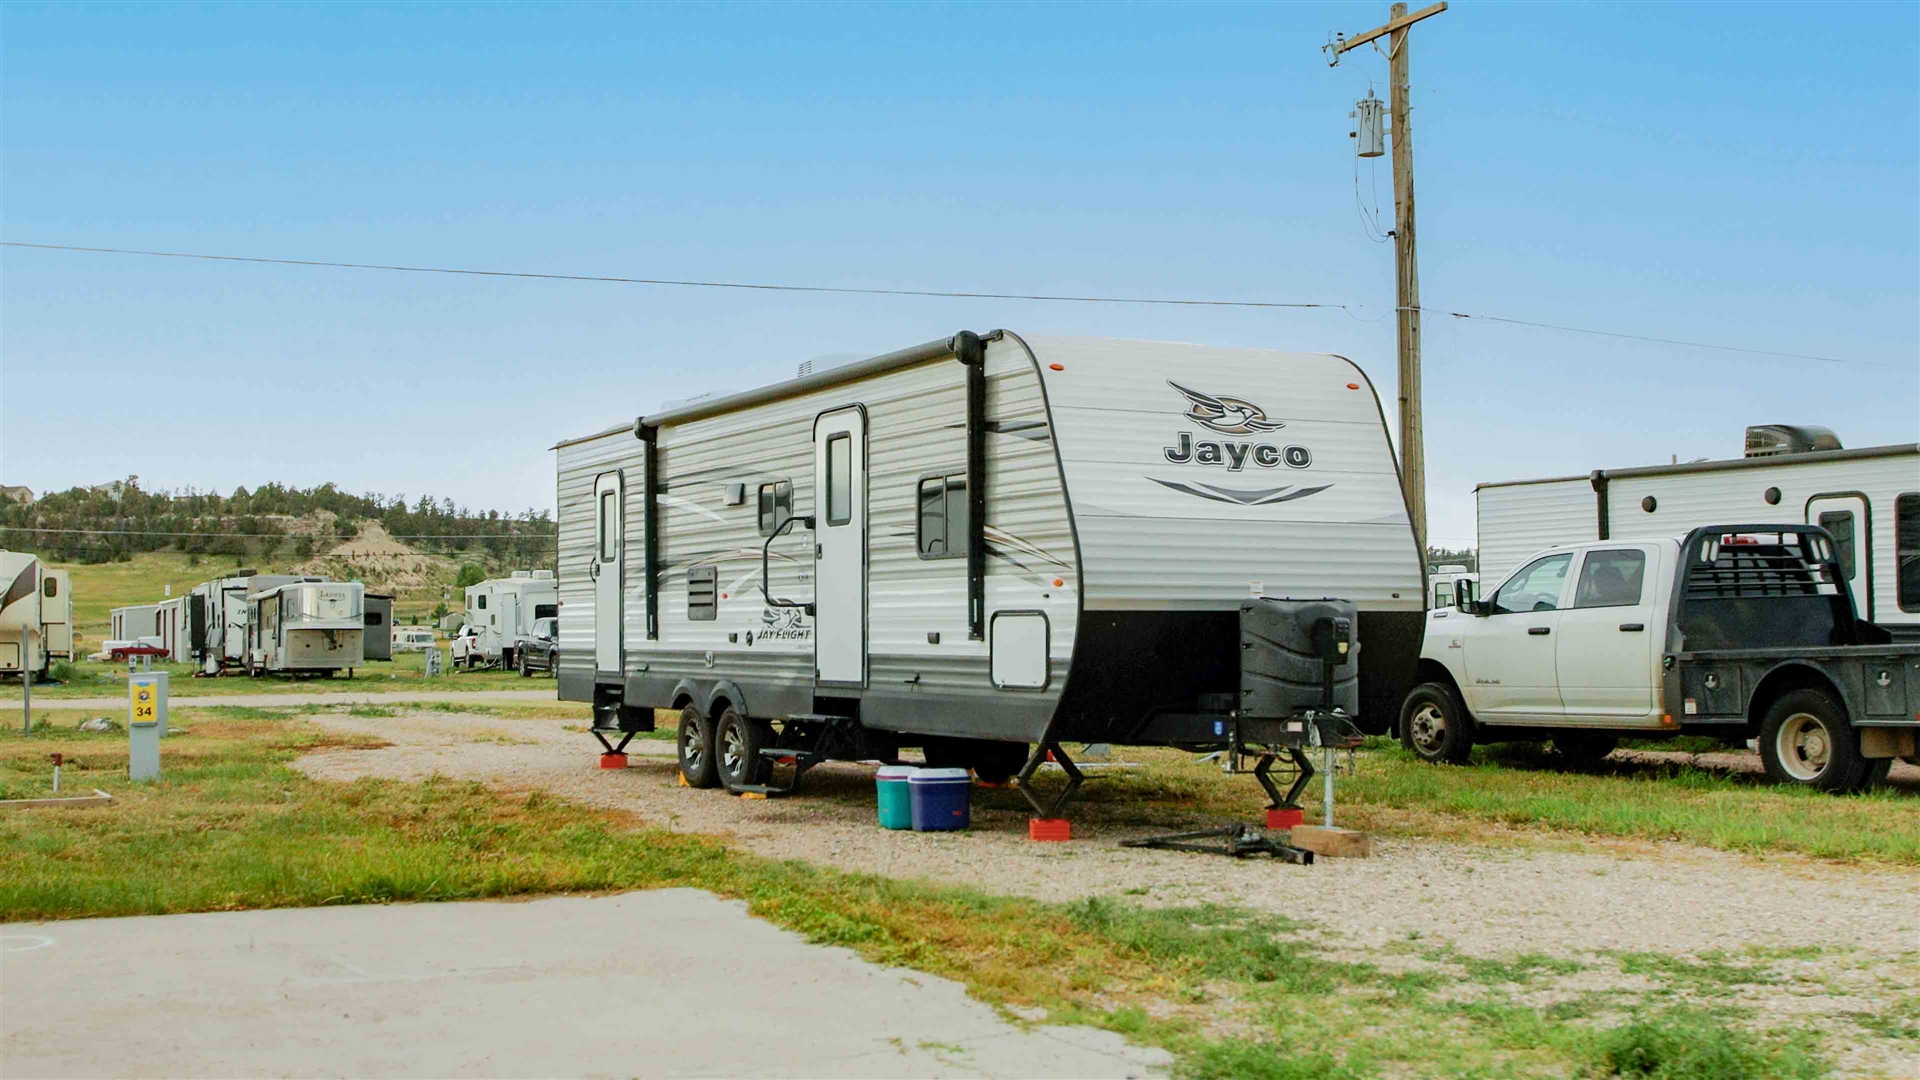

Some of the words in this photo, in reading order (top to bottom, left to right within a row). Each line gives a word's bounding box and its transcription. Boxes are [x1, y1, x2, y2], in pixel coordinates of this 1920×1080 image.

[1164, 431, 1313, 472] Jayco
[757, 629, 775, 640] JAY
[775, 629, 812, 640] FLIGHT
[136, 706, 152, 717] 34
